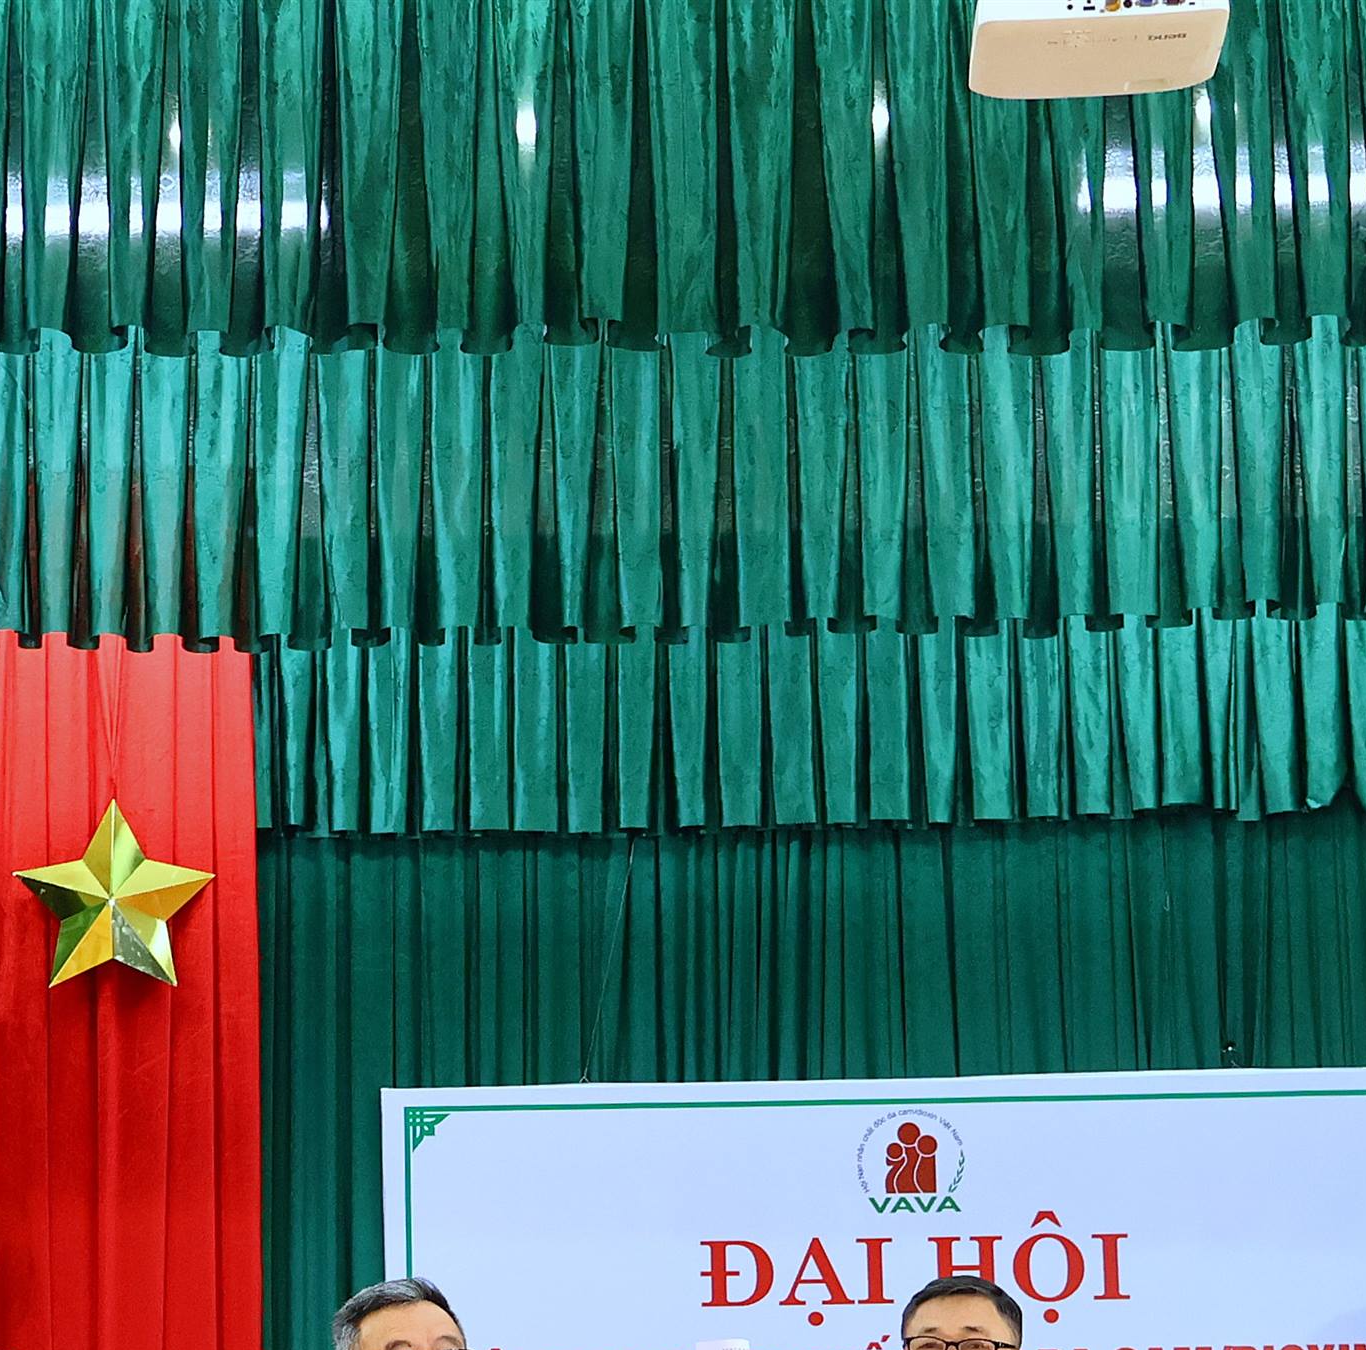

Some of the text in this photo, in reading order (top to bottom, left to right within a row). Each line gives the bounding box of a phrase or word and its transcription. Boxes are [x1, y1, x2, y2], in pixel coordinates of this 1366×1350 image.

[868, 1196, 962, 1214] VAVA
[699, 1210, 1131, 1327] ĐẠI HỘI
